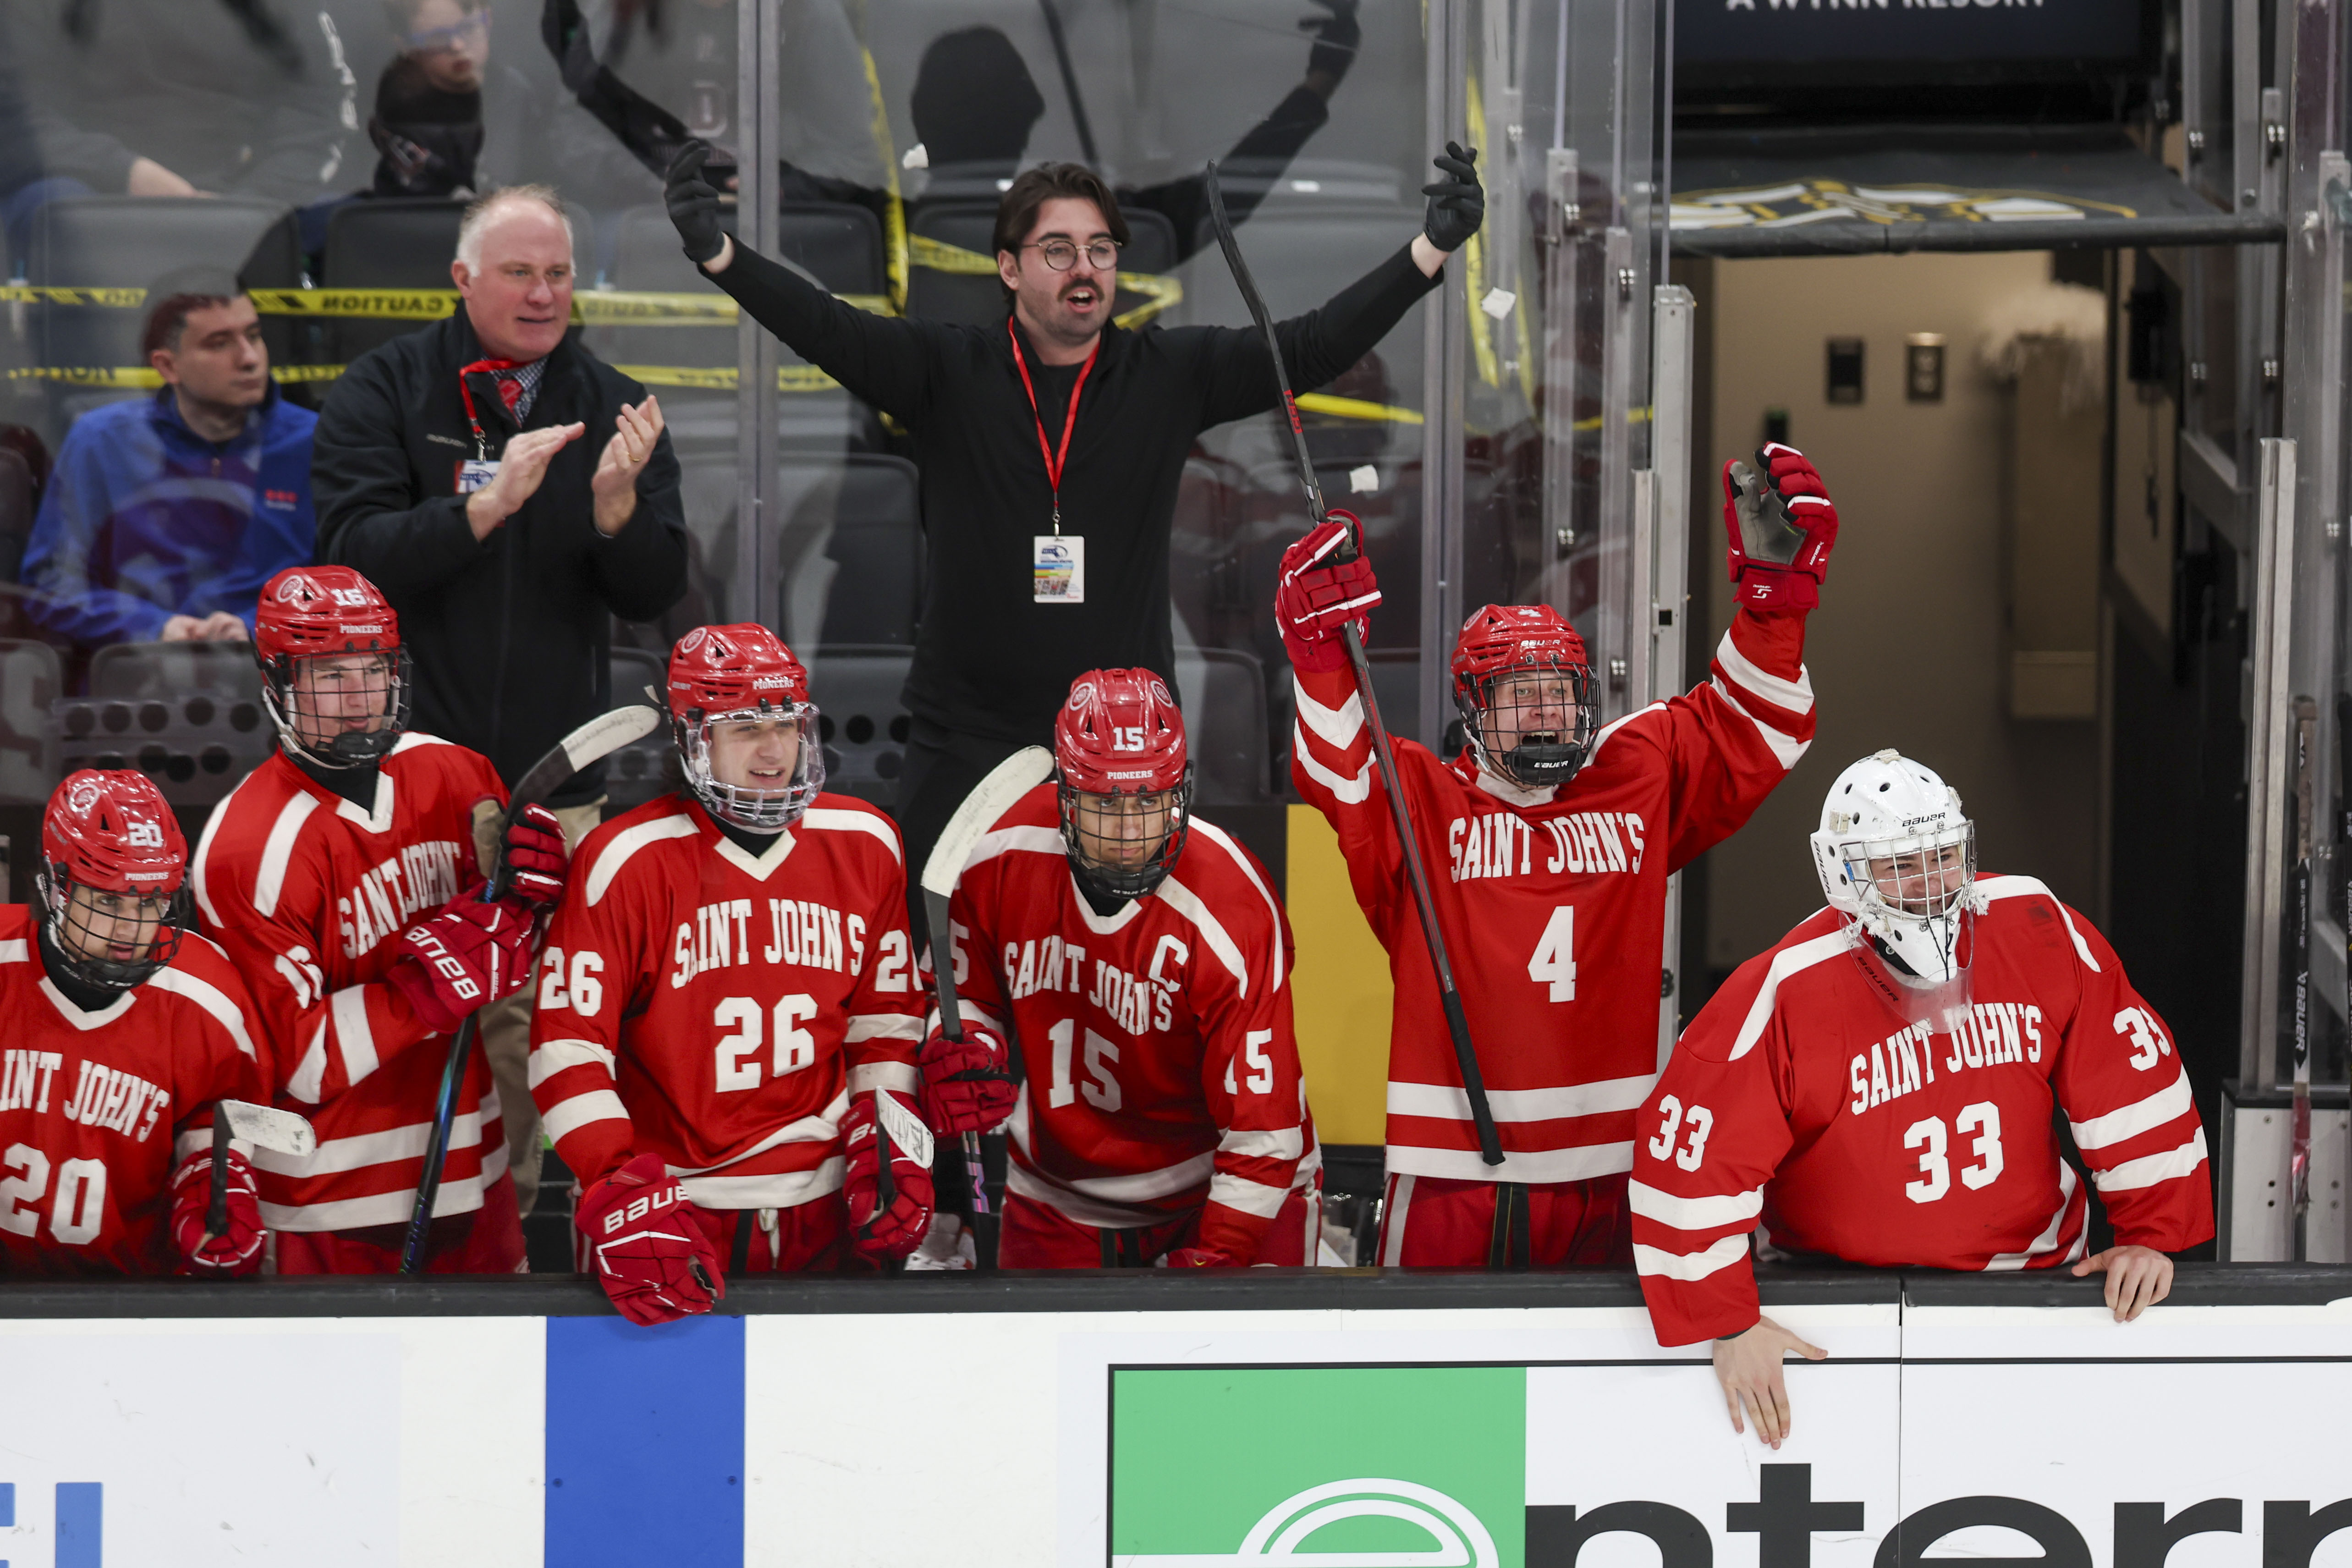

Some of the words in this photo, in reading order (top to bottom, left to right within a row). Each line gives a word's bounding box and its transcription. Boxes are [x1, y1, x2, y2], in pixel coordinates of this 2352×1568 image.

[331, 589, 367, 606] 16
[340, 625, 383, 633] PIONEERS
[753, 679, 795, 689] PIONEERS
[1113, 727, 1145, 751] 15
[1107, 770, 1153, 779] PIONEERS
[127, 822, 163, 847] 20
[1449, 812, 1535, 883] SAINT
[1540, 812, 1644, 874] JOHN'S
[1902, 812, 1945, 827] BAUER
[125, 872, 169, 881] PIONEERS
[1814, 840, 1832, 894] BAUER
[275, 946, 324, 1009] 16
[405, 925, 481, 1000] BAUE
[671, 898, 753, 989] SINT
[875, 930, 923, 992] 2
[1148, 934, 1189, 992] C
[1527, 905, 1577, 1002] 4
[539, 946, 604, 1017] 26
[1004, 935, 1086, 1000] SAINT
[1088, 958, 1173, 1035] JOHN'S
[1857, 956, 1899, 1002] BAUER
[714, 993, 818, 1093] 26
[2295, 984, 2307, 1052] BAUER
[1048, 1018, 1122, 1113] 15
[1224, 1027, 1274, 1095] 15
[1850, 1018, 1934, 1115] SAINT
[1945, 1002, 2042, 1073] JOHN'S
[63, 1059, 170, 1143] JOHN'S
[1648, 1094, 1714, 1173] 33
[1903, 1100, 2004, 1204] 33
[0, 1142, 107, 1245] 20
[604, 1186, 690, 1235] BAUE
